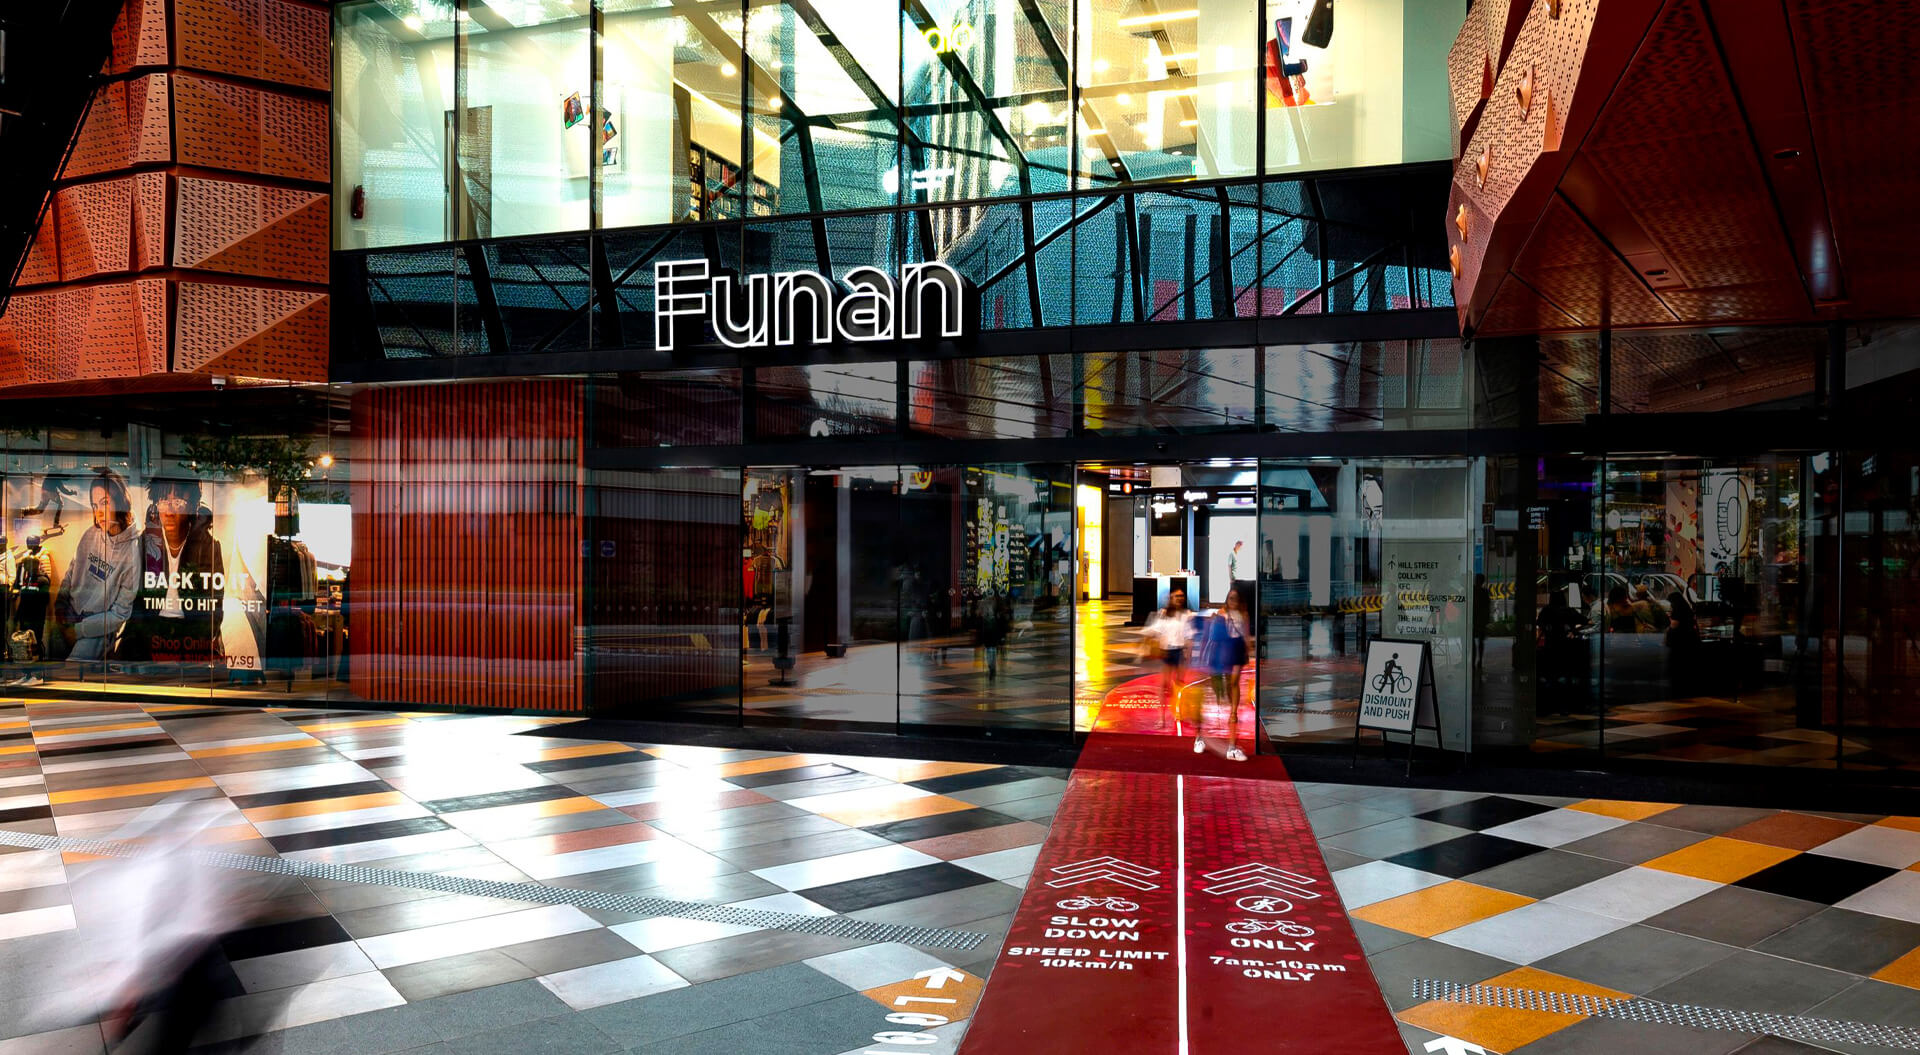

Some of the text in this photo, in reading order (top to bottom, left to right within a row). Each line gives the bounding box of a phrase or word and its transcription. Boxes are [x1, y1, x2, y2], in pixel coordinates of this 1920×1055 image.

[655, 258, 963, 351] Funan
[144, 571, 194, 590] BACK
[199, 572, 225, 590] TO
[1398, 572, 1427, 580] COLLIN'S
[143, 597, 263, 612] TIME TO HIT SET
[151, 635, 181, 650] Shop
[1365, 694, 1413, 708] DISMOUNT
[1364, 706, 1410, 720] AND PUSH
[1050, 916, 1140, 928] SLOW
[1044, 928, 1140, 941] DOWN
[1230, 937, 1315, 952] ONLY
[1007, 947, 1169, 960] SPEED LIMIT
[1039, 958, 1133, 970] 10km/h
[1209, 955, 1346, 972] 7am-10am
[1243, 969, 1315, 982] ONLY
